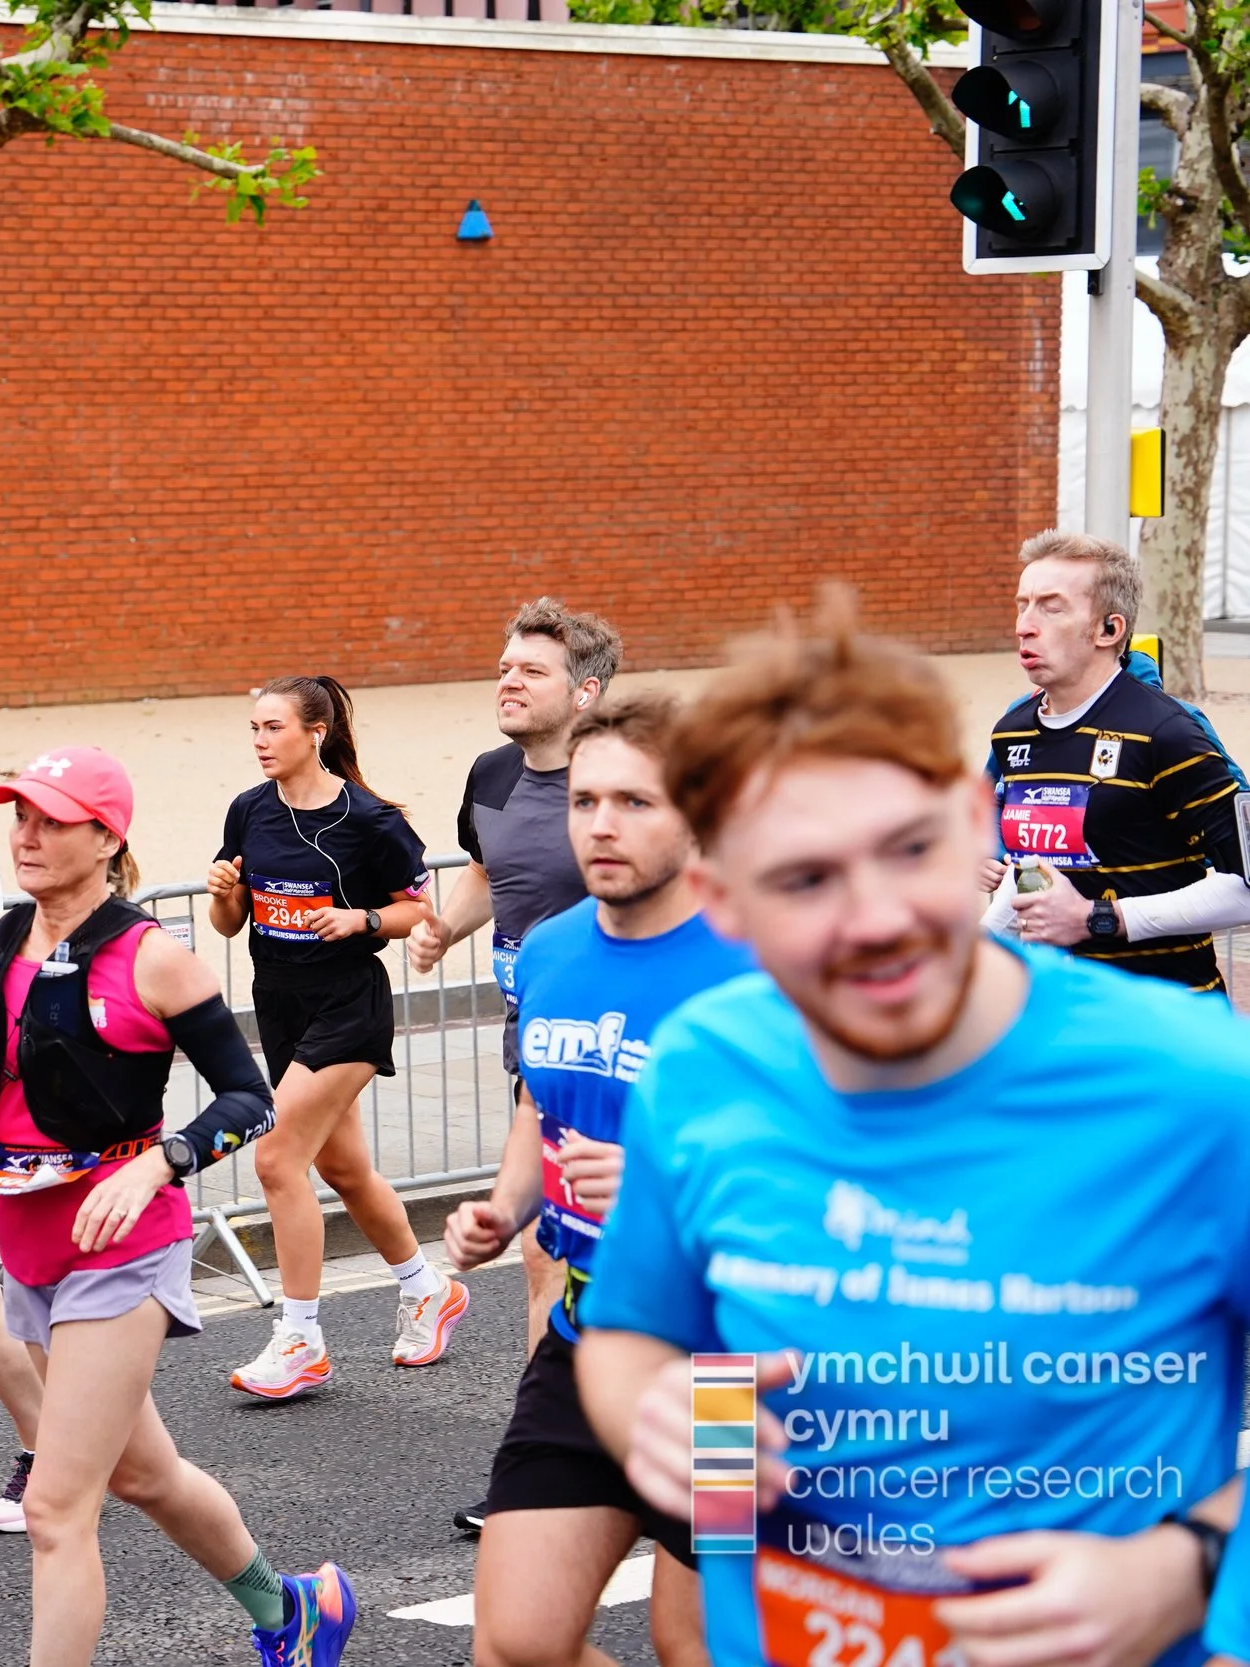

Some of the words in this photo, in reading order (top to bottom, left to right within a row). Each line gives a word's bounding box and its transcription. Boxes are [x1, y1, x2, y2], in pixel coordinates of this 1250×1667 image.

[1003, 809, 1031, 821] JAMIE
[1018, 822, 1069, 850] 5772
[284, 881, 314, 890] SWANSEA
[253, 892, 288, 907] BROOKE
[522, 1011, 626, 1077] emf
